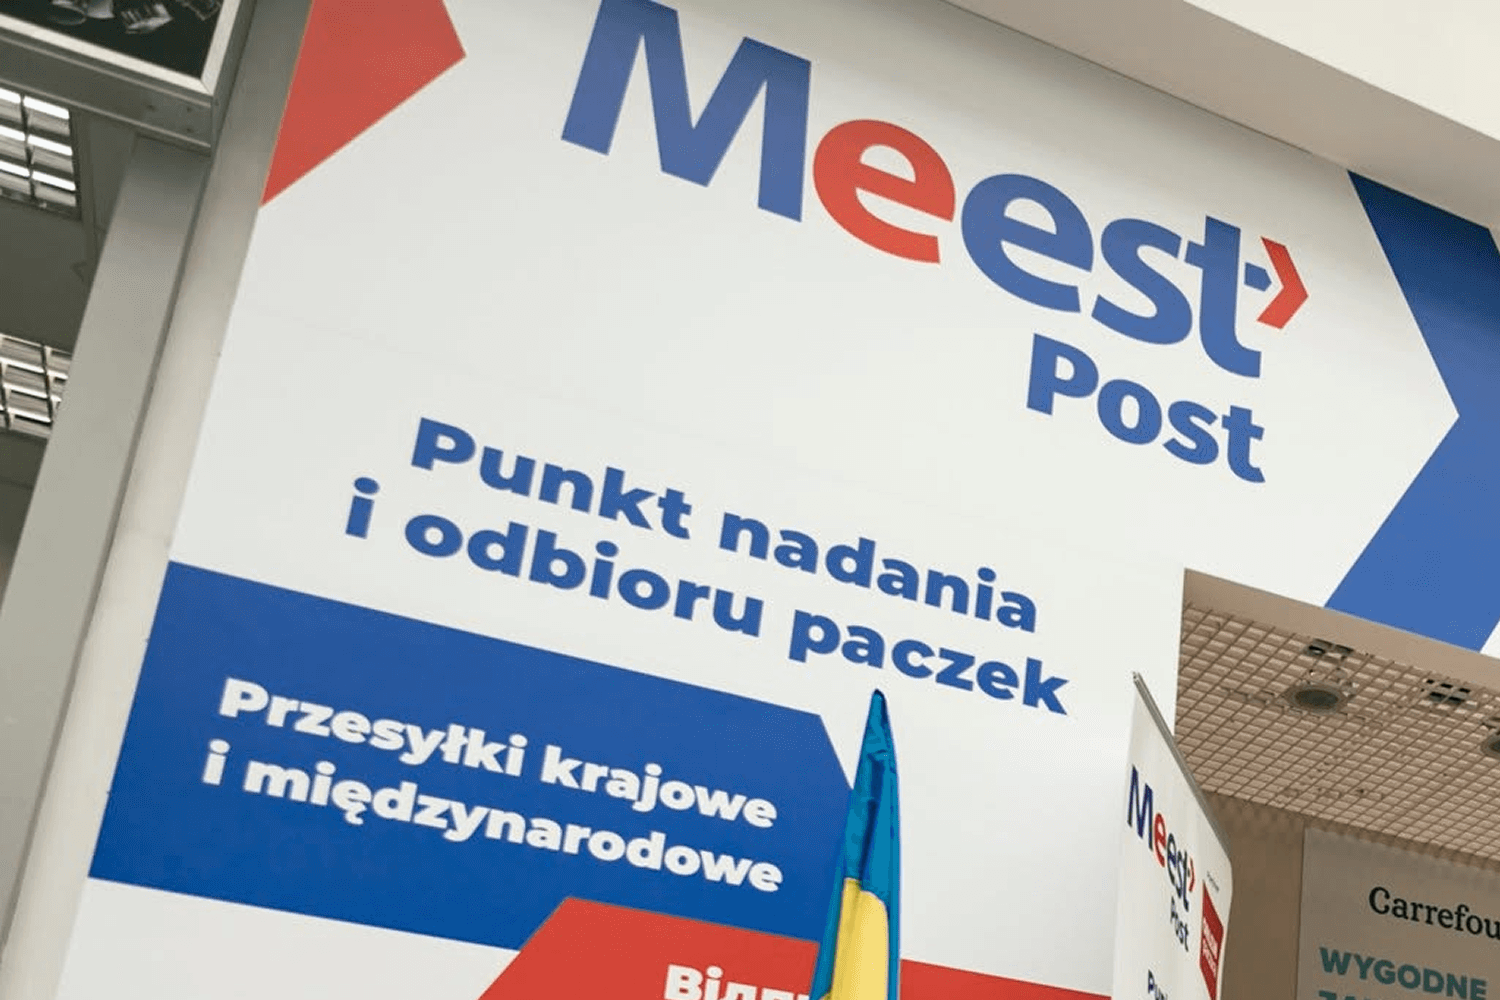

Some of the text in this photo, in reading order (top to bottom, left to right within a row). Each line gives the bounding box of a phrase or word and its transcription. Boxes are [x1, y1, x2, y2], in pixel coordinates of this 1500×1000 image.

[561, 0, 1275, 378] Meest
[1026, 333, 1265, 483] Post
[345, 476, 1069, 716] i odbioru paczek
[411, 417, 1037, 633] Punkt nadania
[201, 738, 783, 892] i międzynarodowe
[218, 678, 777, 828] Przesyłki krajowe
[1127, 765, 1190, 913] Meest
